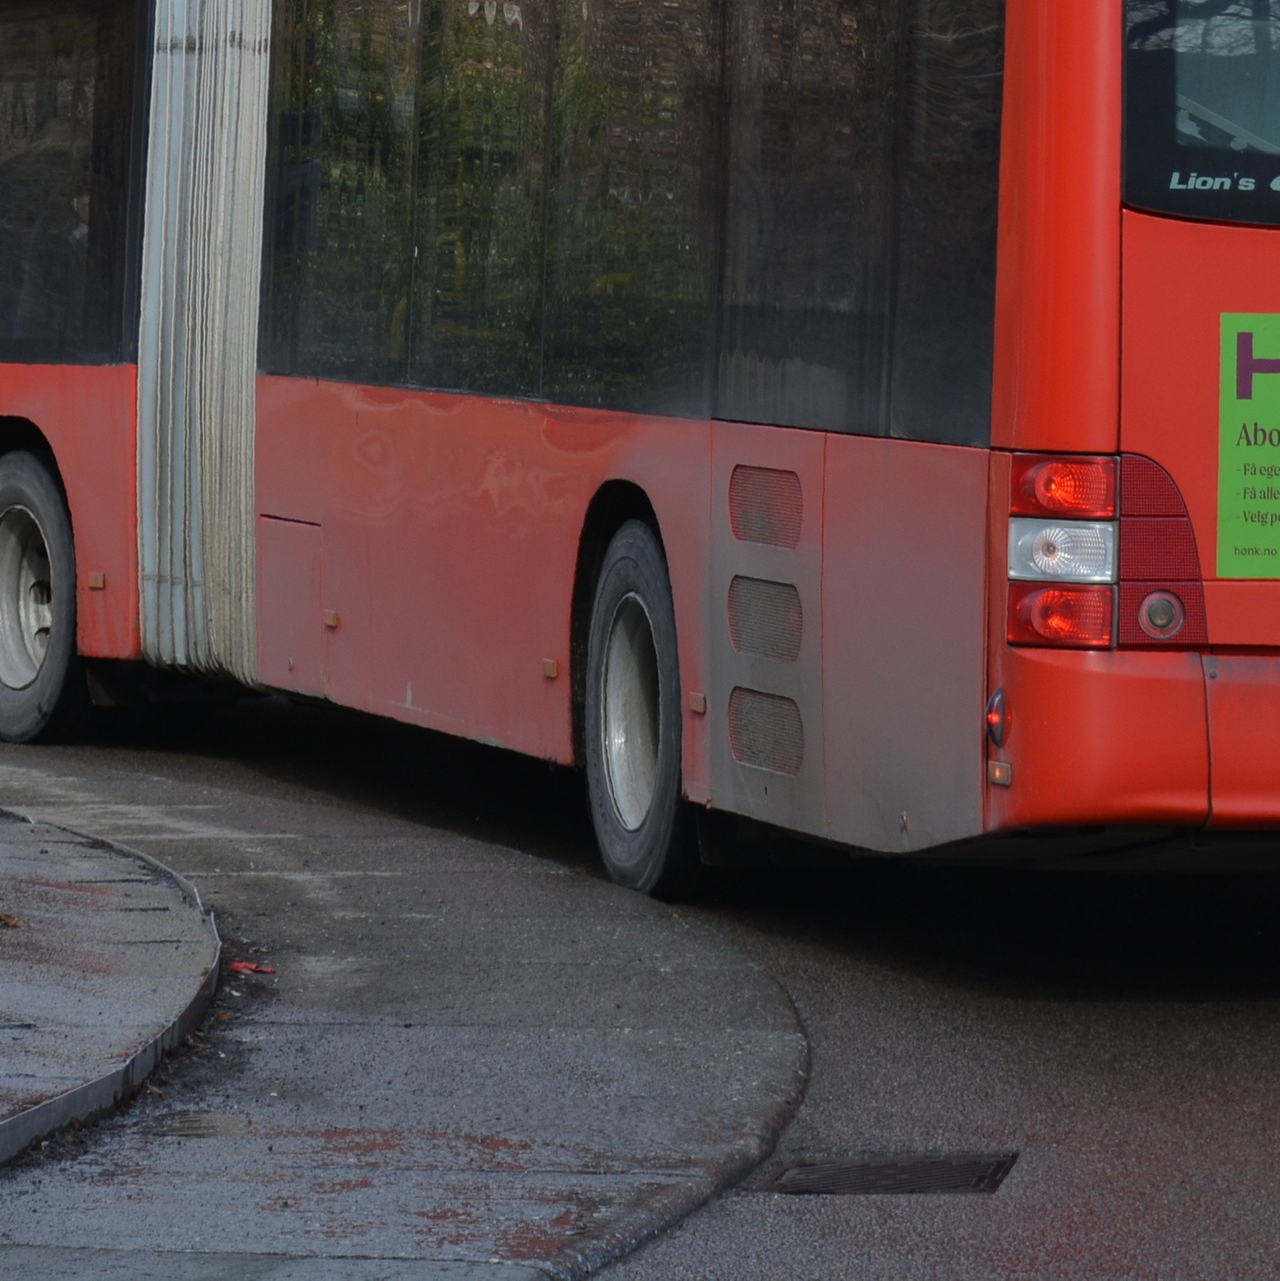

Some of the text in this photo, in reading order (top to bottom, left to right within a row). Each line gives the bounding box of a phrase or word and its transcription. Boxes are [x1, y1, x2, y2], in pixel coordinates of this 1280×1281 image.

[1169, 172, 1255, 191] Lion's
[1243, 463, 1257, 476] Få
[1243, 487, 1257, 500] Få
[1259, 487, 1280, 500] alle
[1243, 511, 1269, 526] Velg
[1234, 546, 1278, 557] honk.no
